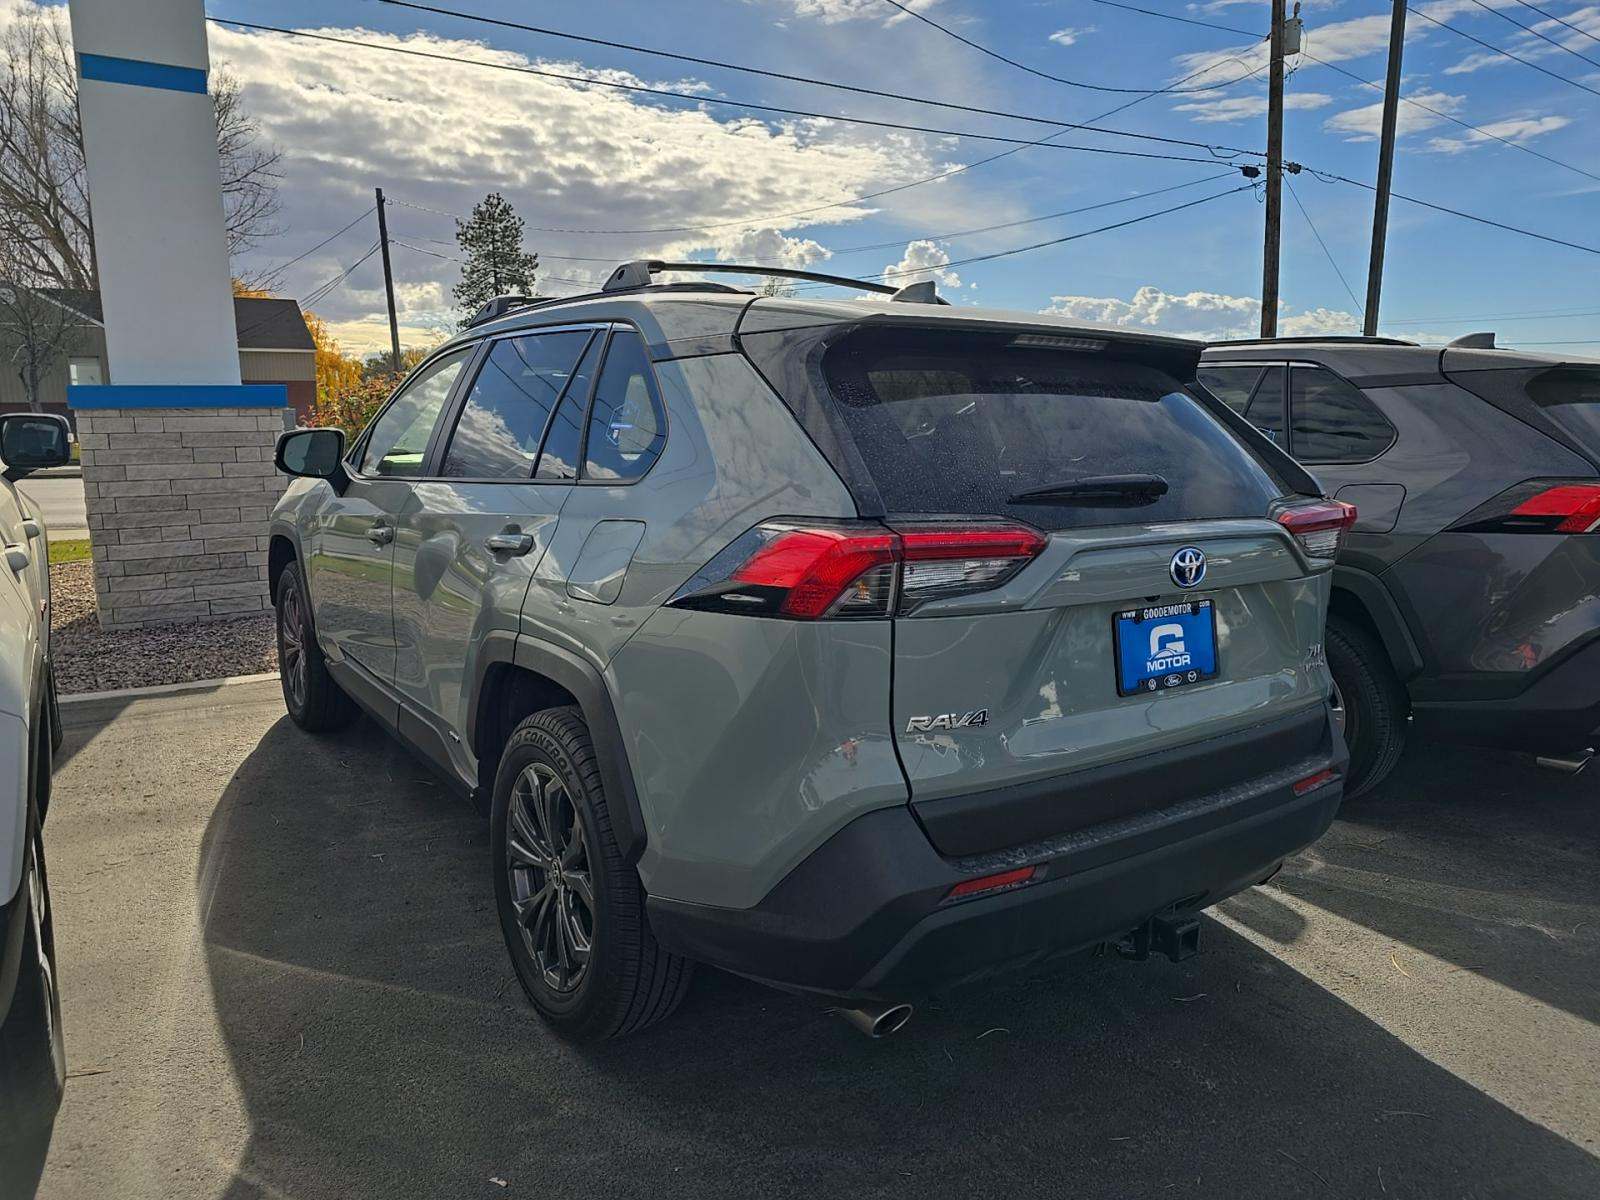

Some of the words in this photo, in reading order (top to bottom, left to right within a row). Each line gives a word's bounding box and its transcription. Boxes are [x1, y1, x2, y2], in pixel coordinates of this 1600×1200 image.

[1143, 603, 1192, 619] GOODEMOTOR
[1147, 655, 1191, 673] MOTOR
[905, 708, 989, 733] RAV4
[524, 730, 573, 782] CONTROL
